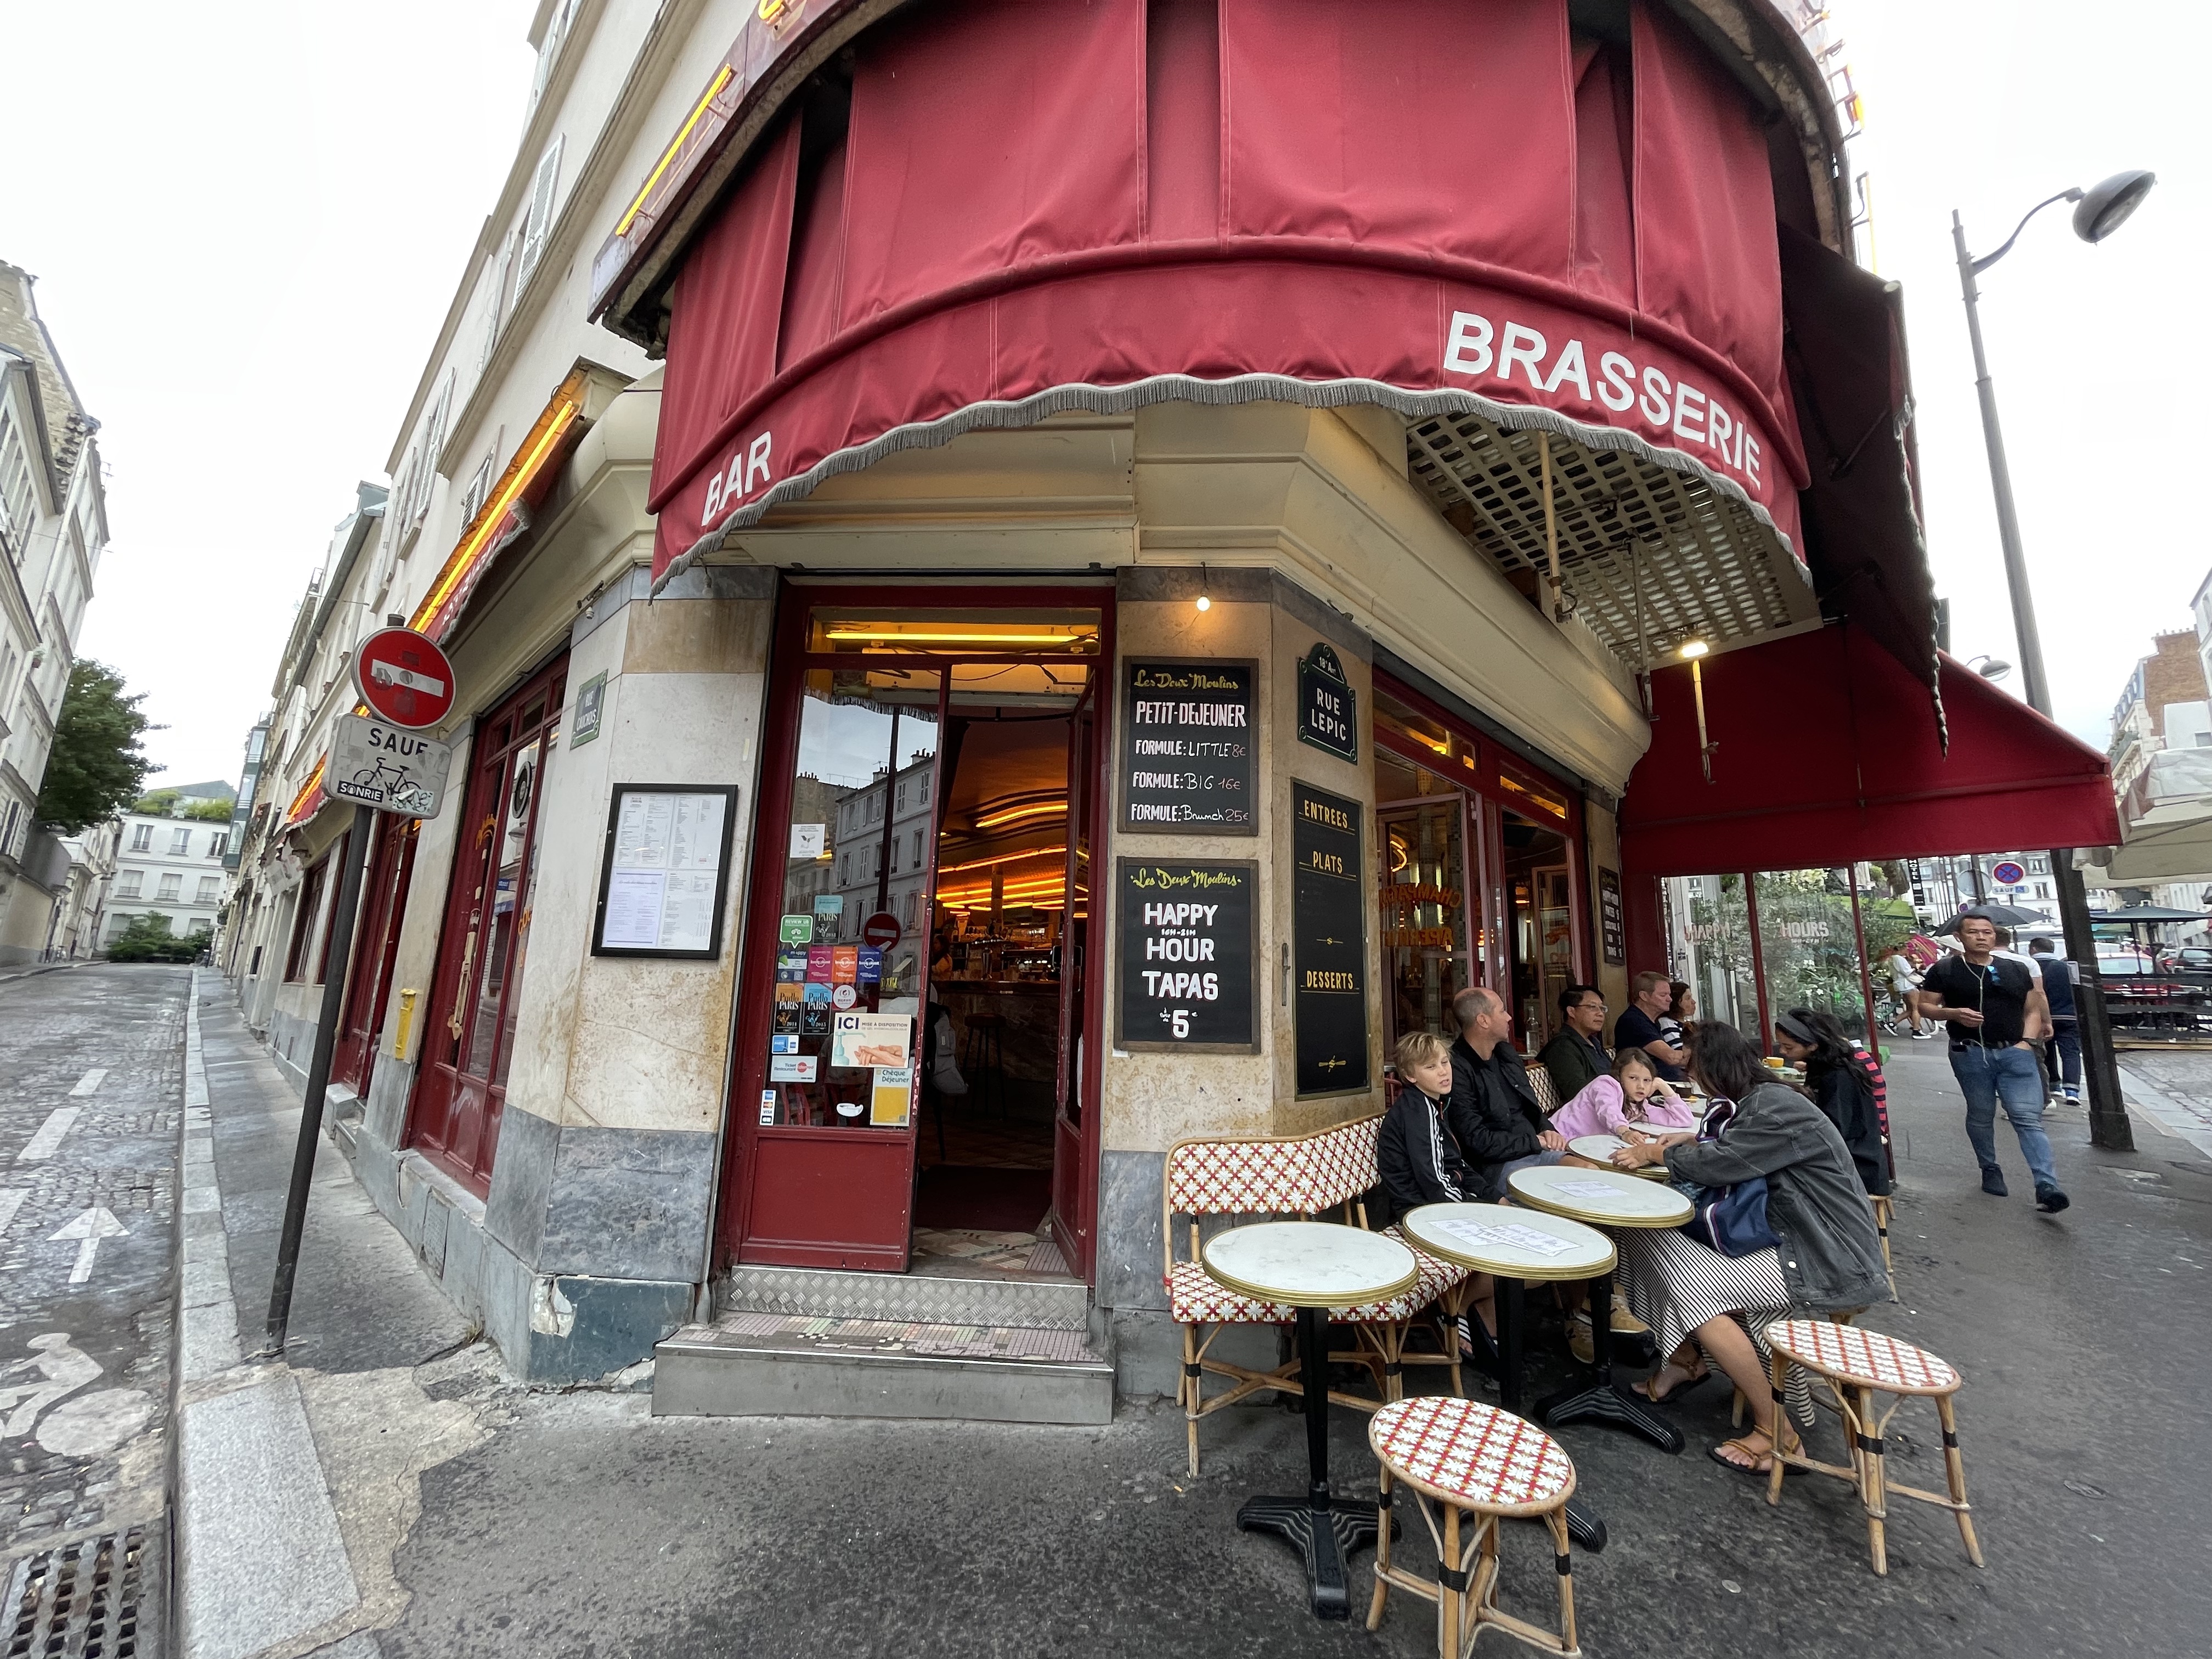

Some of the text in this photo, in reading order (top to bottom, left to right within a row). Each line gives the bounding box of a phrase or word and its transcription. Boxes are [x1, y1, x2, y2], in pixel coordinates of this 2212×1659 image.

[1443, 310, 1762, 491] BRASSERIE
[701, 431, 772, 527] BAR
[1134, 669, 1239, 689] Les Deux Moulins
[1317, 687, 1340, 716] RUE
[1311, 708, 1347, 741] LEPIC
[368, 727, 428, 756] SAUF
[1188, 741, 1232, 757] LITTLE
[1184, 772, 1214, 789] BIG
[1218, 777, 1240, 790] 16€
[1181, 804, 1224, 821] Brunch
[1225, 809, 1249, 822] 25€
[1313, 850, 1342, 874] PLATS
[1133, 867, 1155, 888] Les
[1156, 868, 1191, 889] Deux
[818, 913, 838, 922] PARIS
[1143, 902, 1218, 927] HAPPY
[1781, 921, 1830, 938] HOURS
[1147, 938, 1215, 962] HOUR
[1142, 970, 1218, 1001] TAPAS
[1307, 970, 1353, 990] DESSERTS
[779, 1001, 799, 1010] PARIS
[808, 1001, 828, 1011] PARIS
[838, 1017, 859, 1030] ICI
[882, 1076, 910, 1084] Déjeuner
